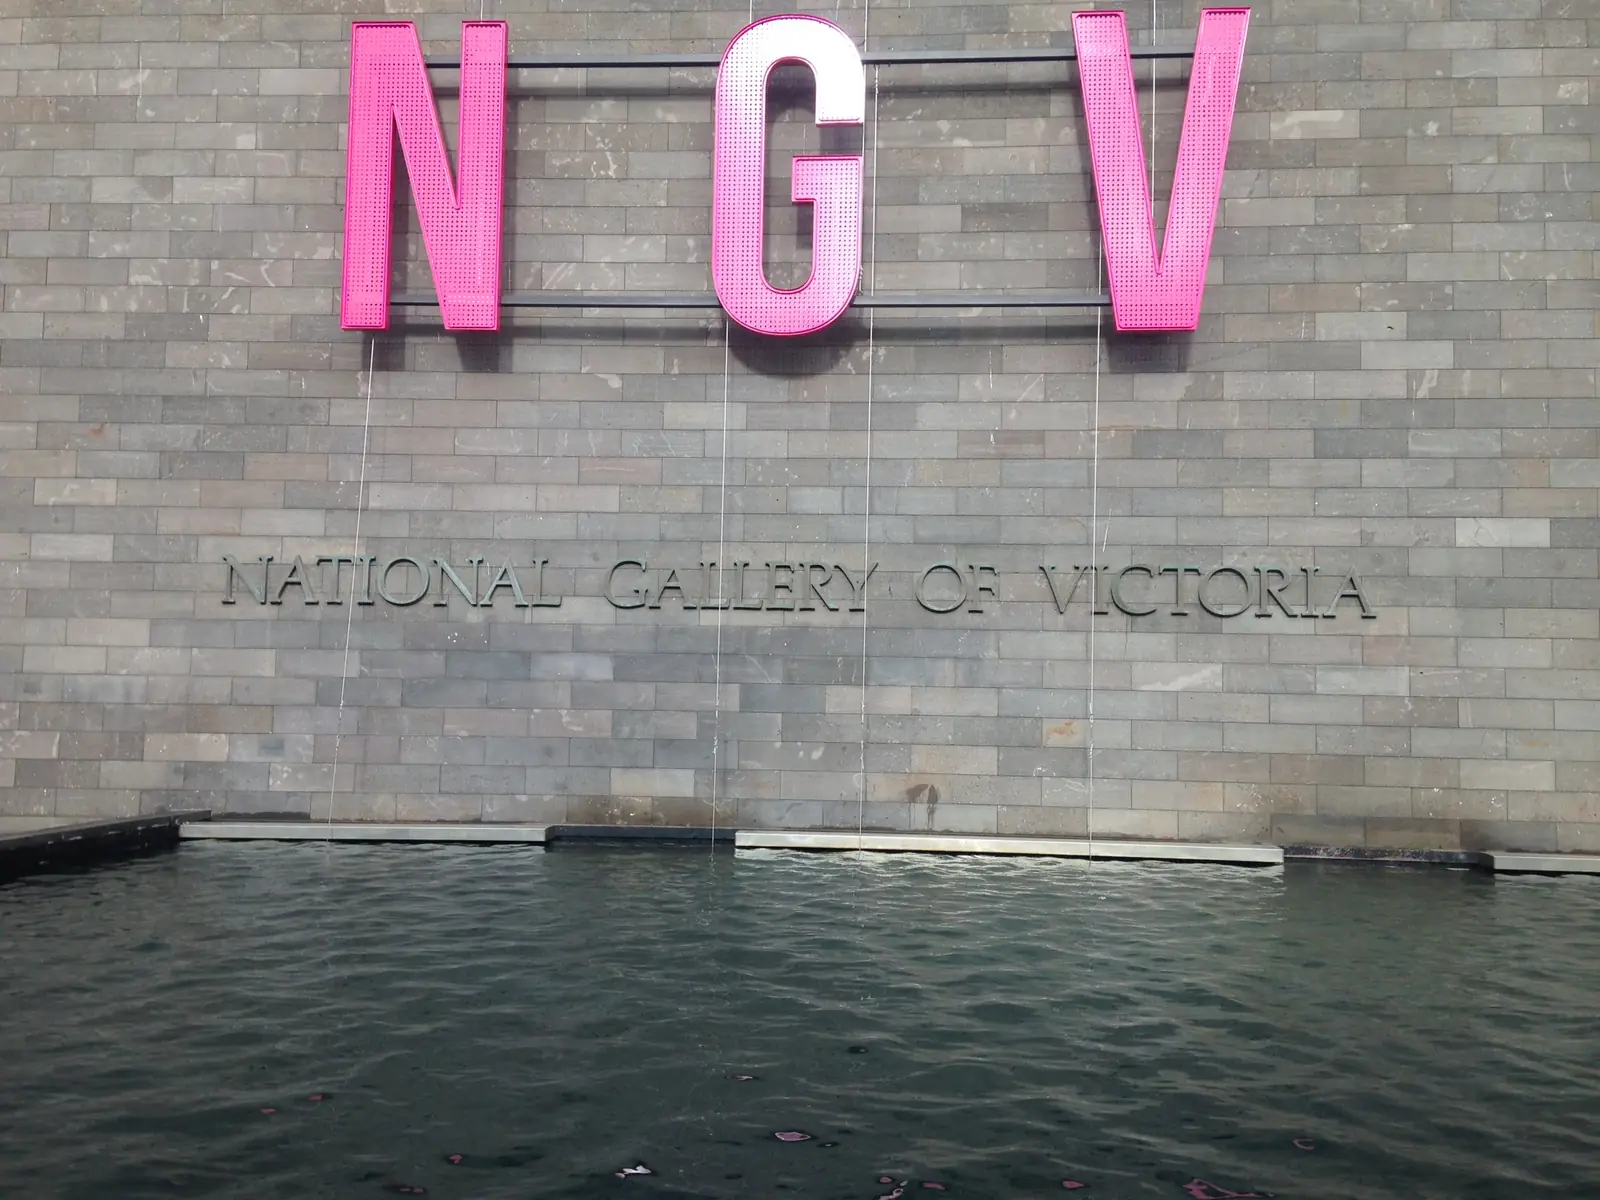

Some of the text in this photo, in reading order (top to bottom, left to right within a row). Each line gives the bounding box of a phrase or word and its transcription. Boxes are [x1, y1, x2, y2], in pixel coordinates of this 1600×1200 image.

[341, 8, 1252, 336] NGV
[222, 555, 1377, 619] NATIONAL GALLERY OF VICTORIA
